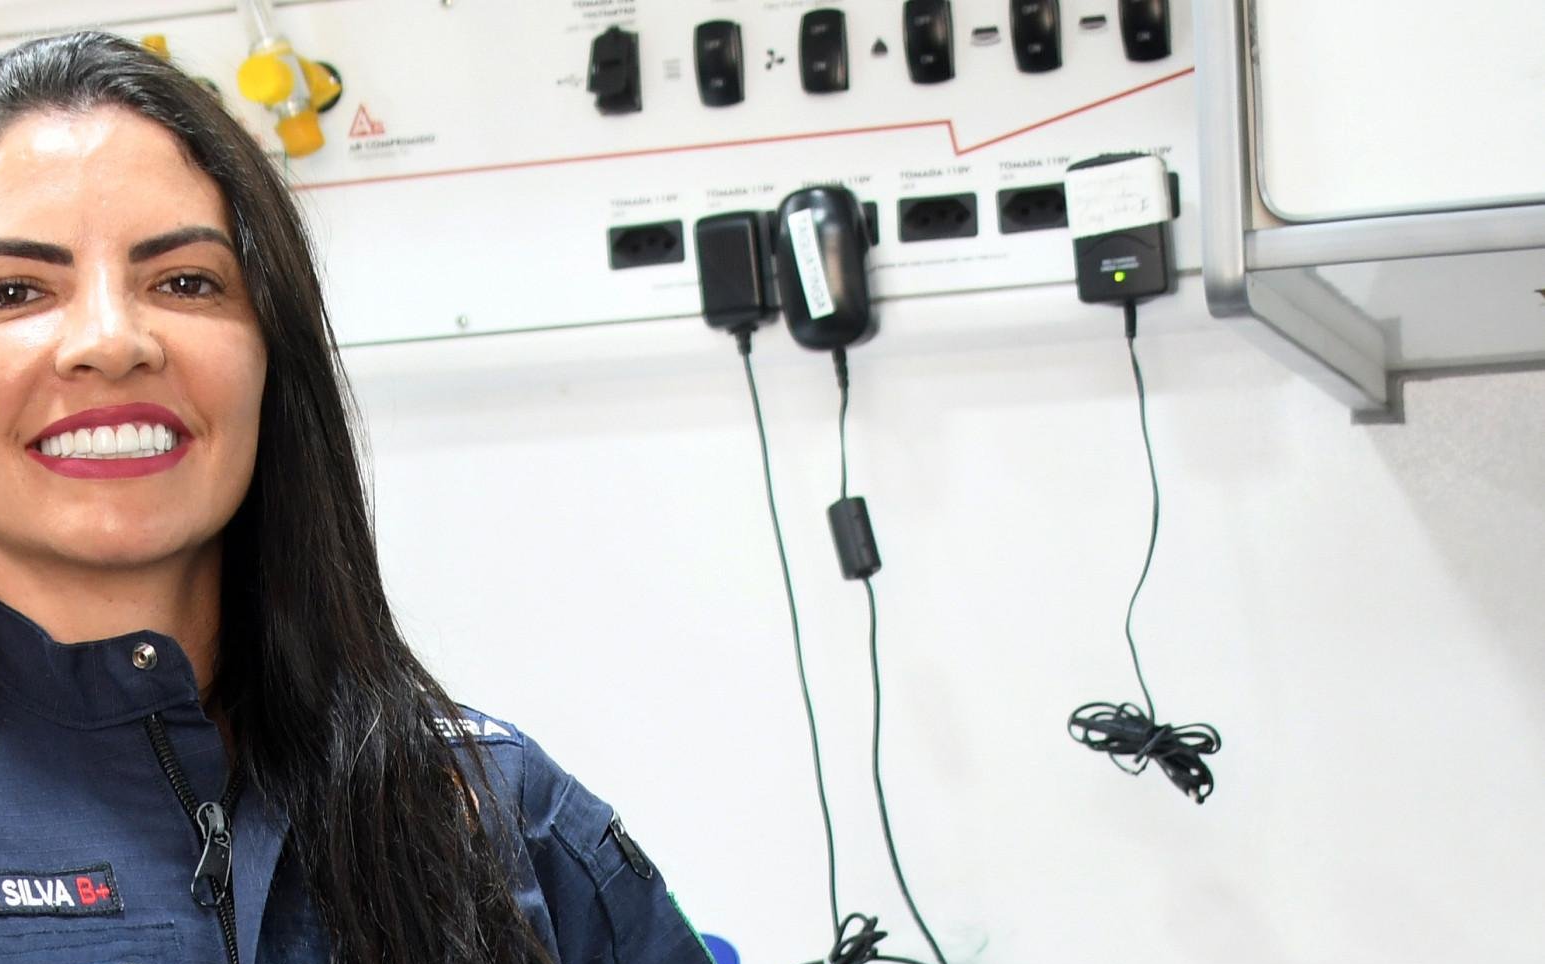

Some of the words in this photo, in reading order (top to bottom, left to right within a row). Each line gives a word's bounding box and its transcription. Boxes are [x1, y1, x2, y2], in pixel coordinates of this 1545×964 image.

[999, 159, 1043, 170] TOMADA
[900, 168, 942, 179] TOMADA
[706, 187, 748, 198] TOMADA
[610, 197, 651, 207] TOMADA
[3, 878, 75, 907] SILVA
[74, 875, 110, 906] B+
